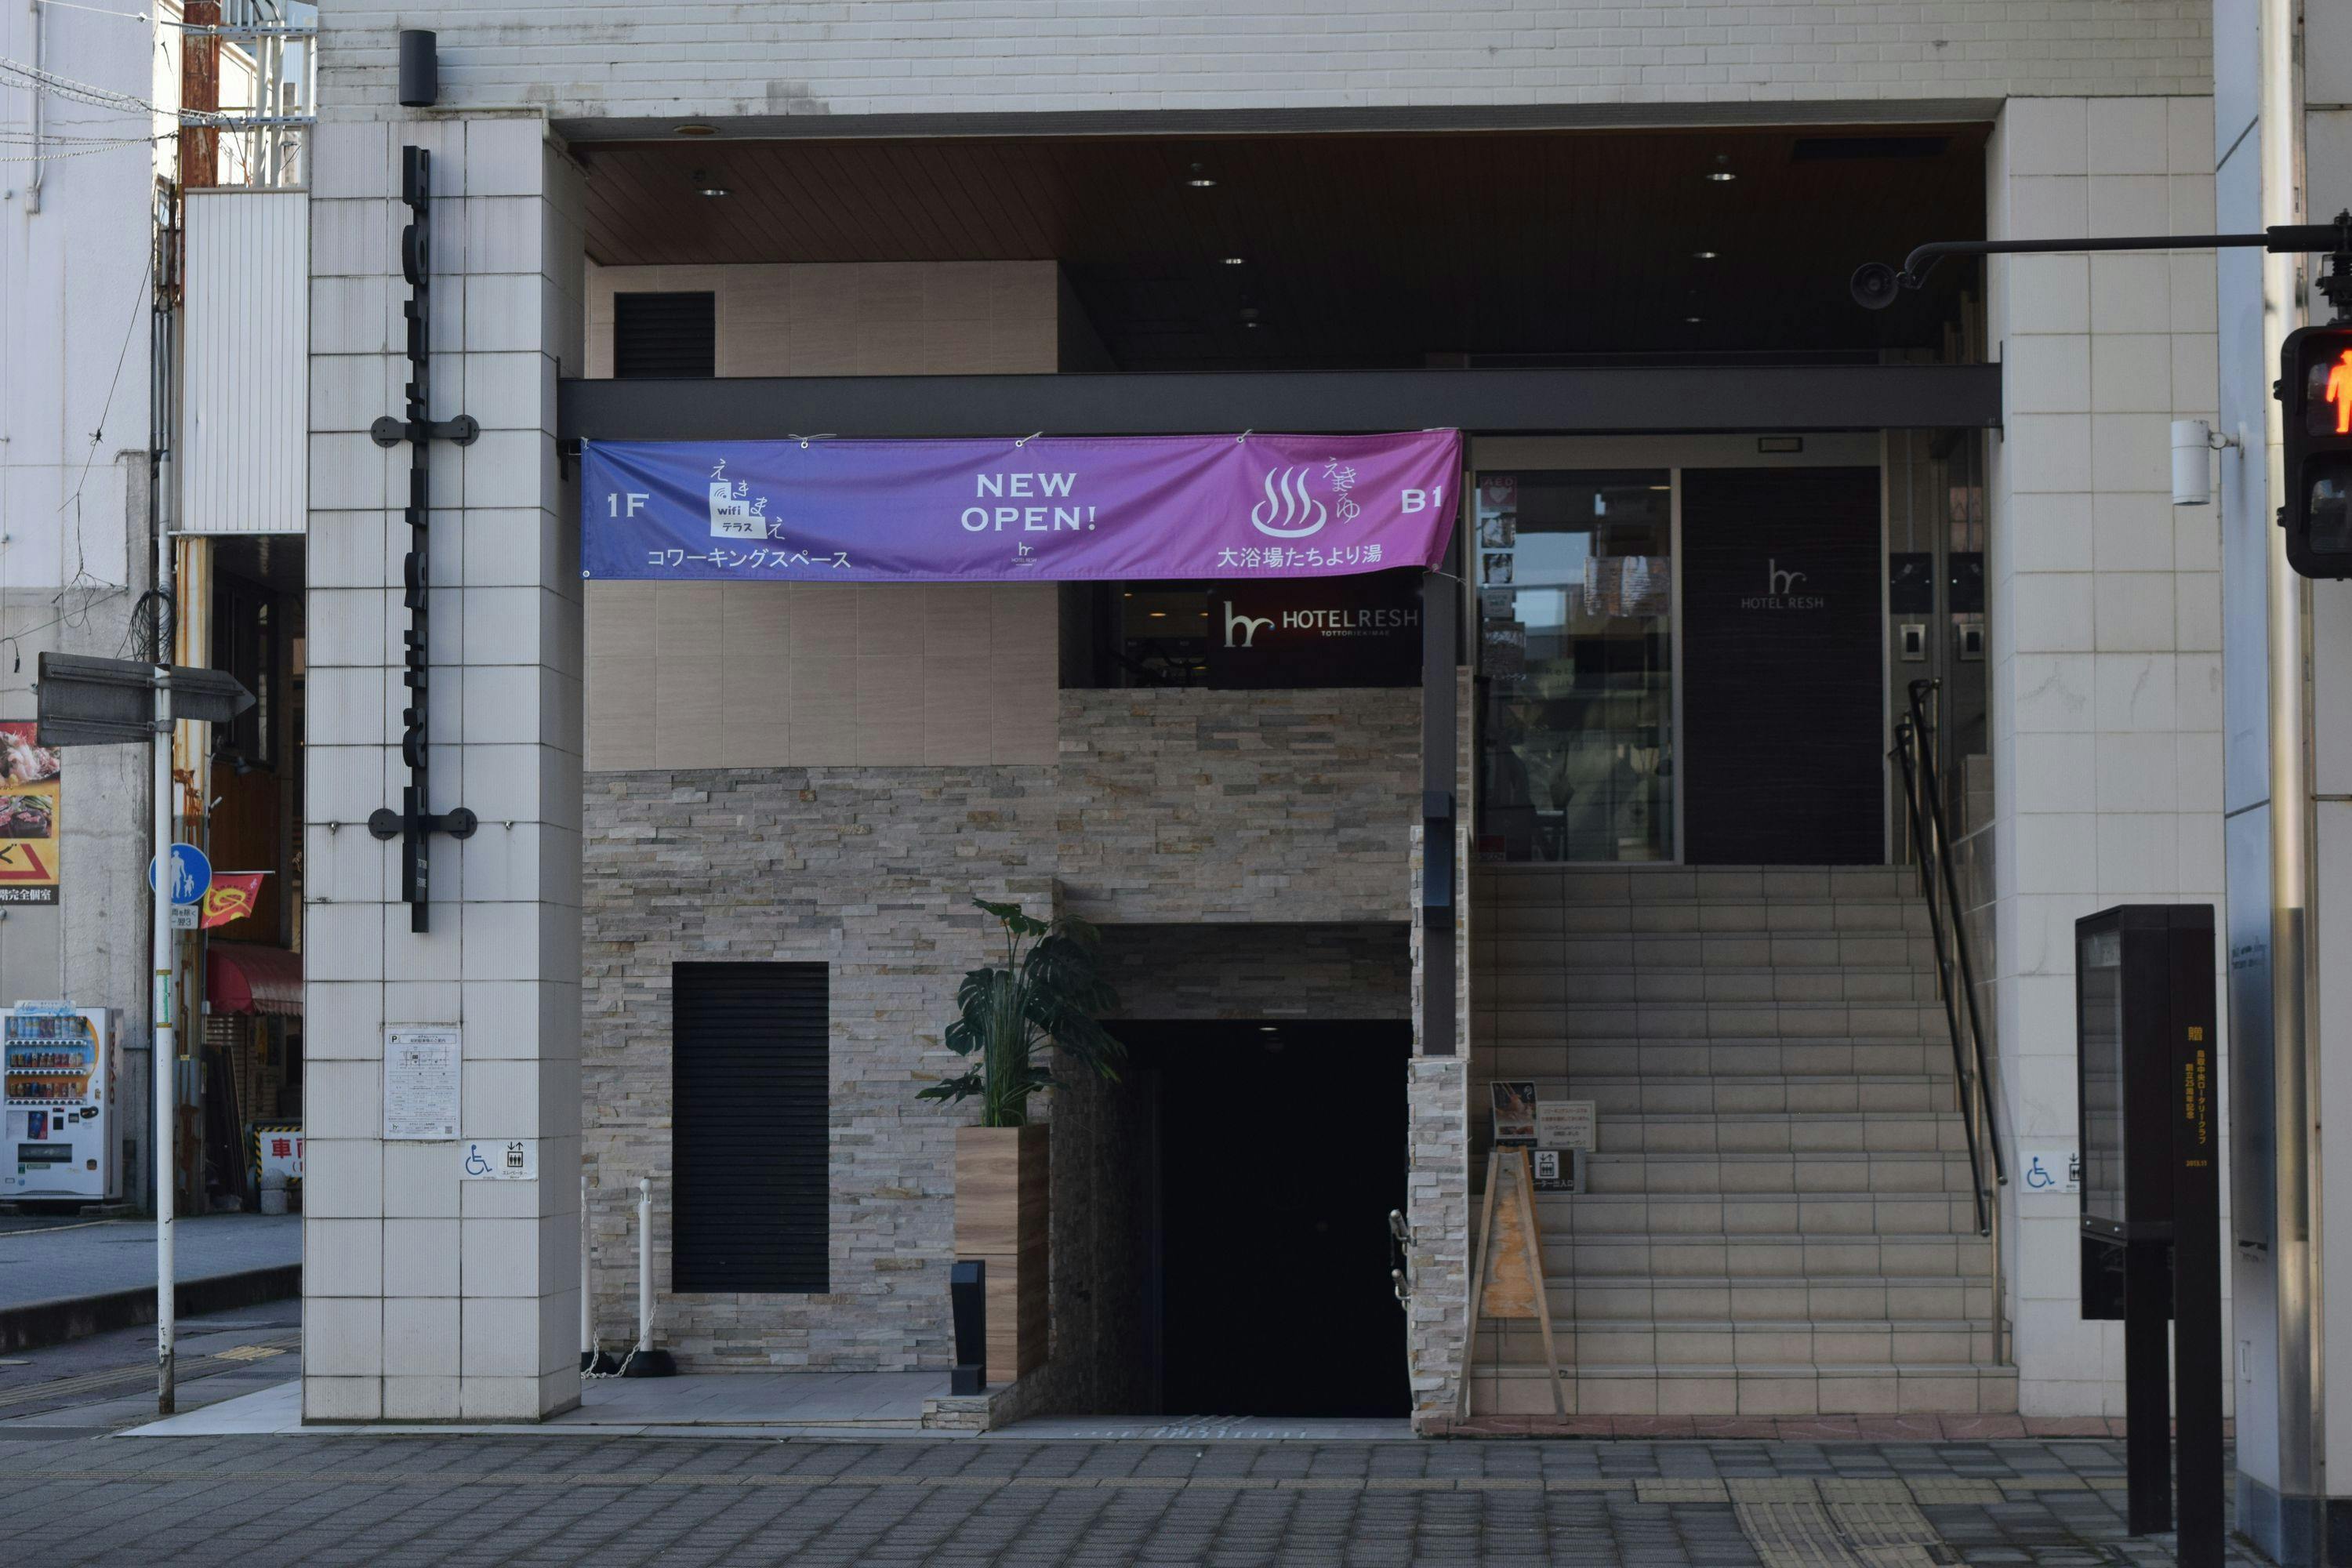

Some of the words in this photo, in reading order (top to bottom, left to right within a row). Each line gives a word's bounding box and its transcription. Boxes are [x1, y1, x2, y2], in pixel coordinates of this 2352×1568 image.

[977, 473, 1076, 497] NEW
[608, 492, 649, 517] 1F
[1402, 485, 1442, 514] B1
[717, 506, 741, 516] wifi
[961, 506, 1097, 532] OPEN!
[722, 522, 753, 532] テラス
[648, 548, 851, 569] コワーキングスペース
[1218, 544, 1383, 568] 大浴場たちより湯
[1741, 597, 1784, 609] HOTEL
[1788, 597, 1824, 608] RESH
[2187, 1026, 2203, 1041] 贈
[1533, 1179, 1573, 1189] ーター出入口
